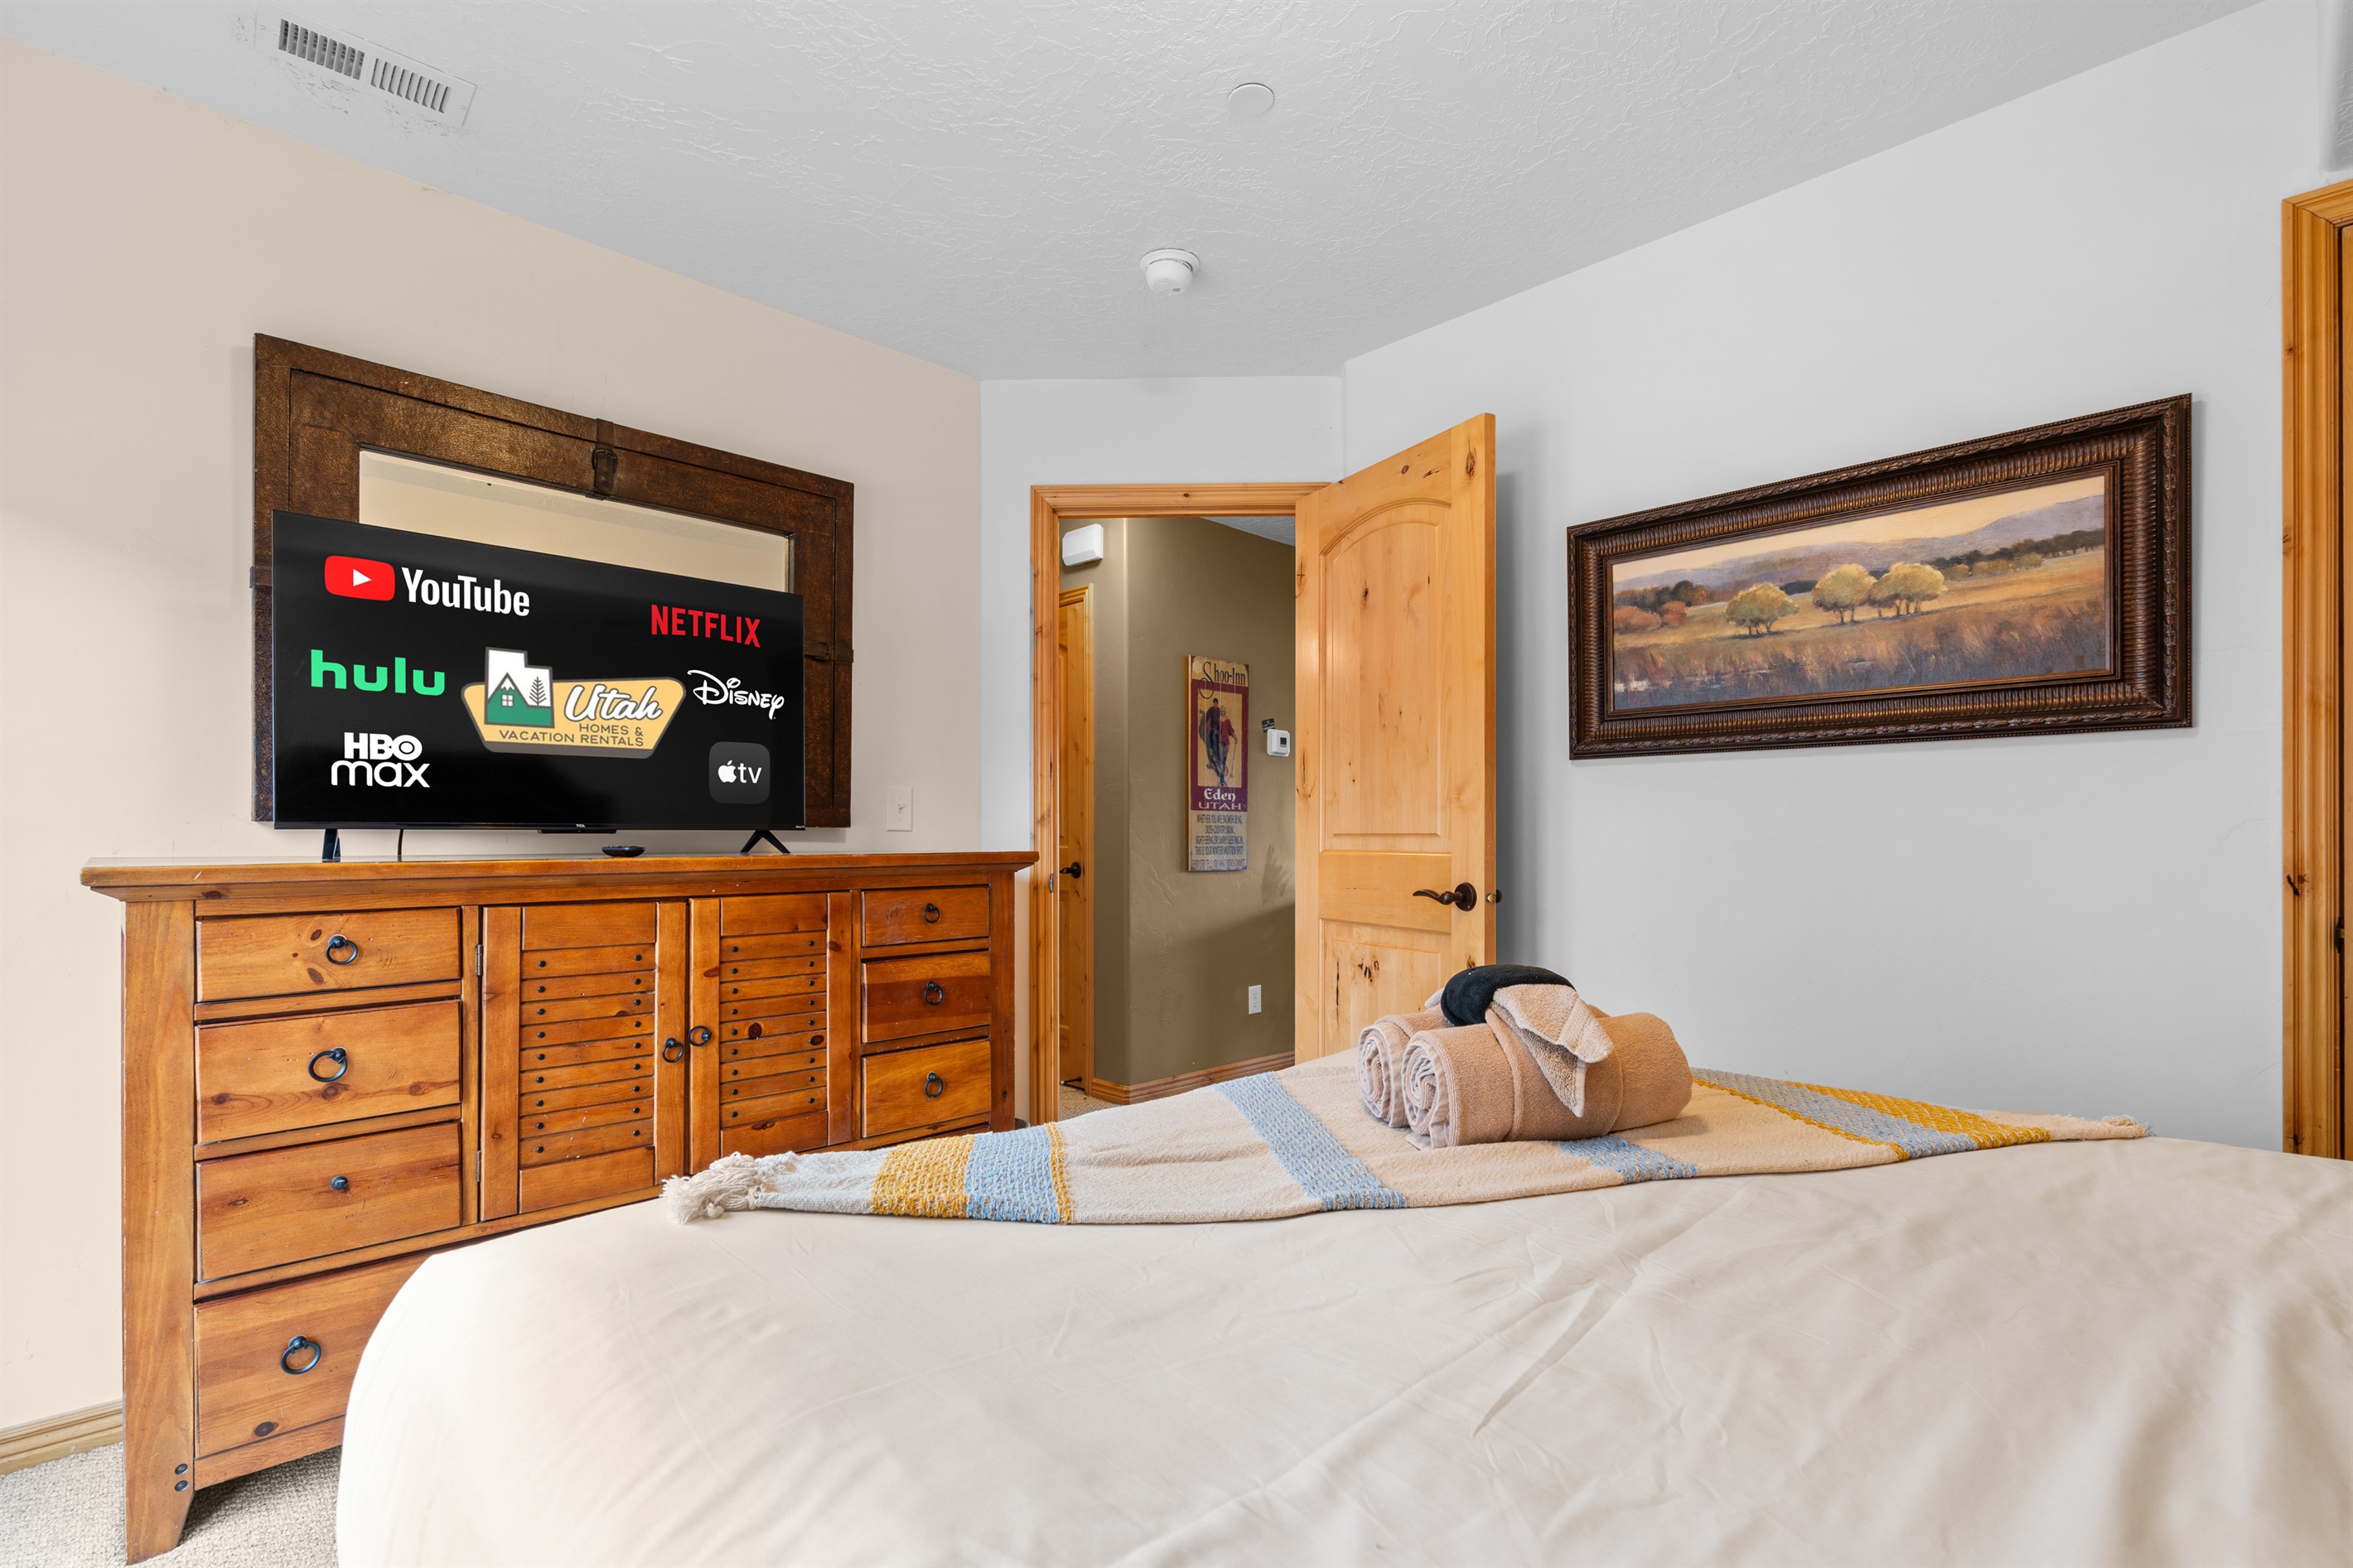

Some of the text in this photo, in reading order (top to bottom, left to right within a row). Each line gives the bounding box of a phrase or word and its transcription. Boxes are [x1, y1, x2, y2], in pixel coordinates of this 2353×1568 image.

[401, 567, 530, 616] YouTube
[651, 604, 761, 648] NETFLIX
[311, 649, 446, 697] hulu
[564, 683, 664, 722] Utah
[499, 729, 644, 747] VACATION RENTALS
[579, 723, 644, 737] HOMES &
[344, 731, 423, 761] HBO
[331, 760, 431, 788] max
[737, 763, 762, 784] tv
[1198, 801, 1241, 810] UTAH
[1204, 788, 1236, 803] Eden
